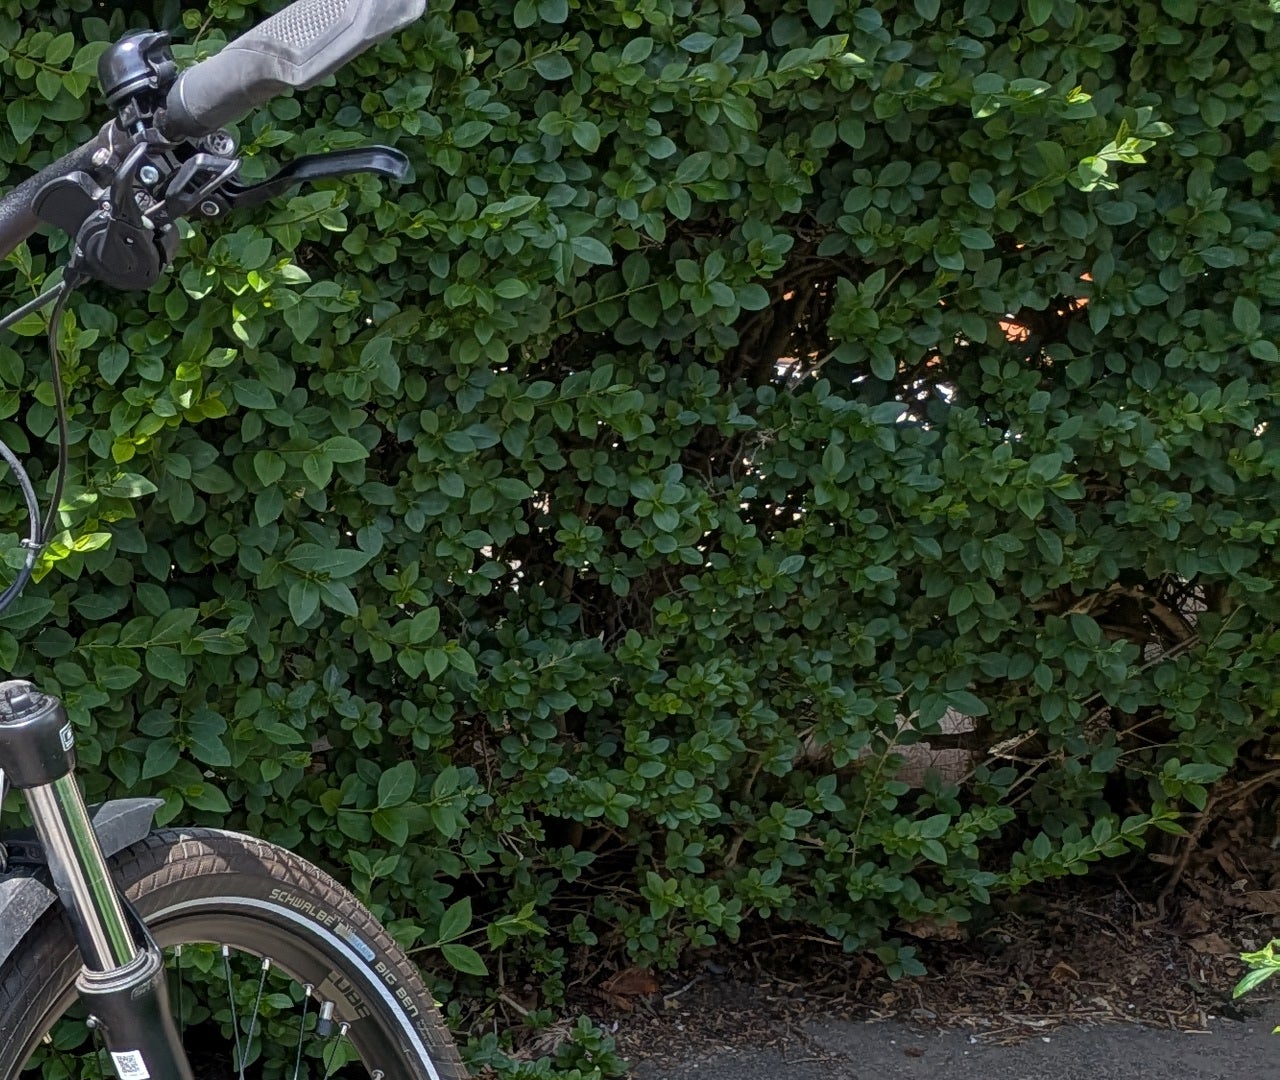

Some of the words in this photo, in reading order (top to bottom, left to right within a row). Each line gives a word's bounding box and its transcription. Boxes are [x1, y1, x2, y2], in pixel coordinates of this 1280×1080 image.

[269, 888, 336, 927] SCHWALBE
[375, 961, 397, 985] BIG
[395, 988, 419, 1018] BEN
